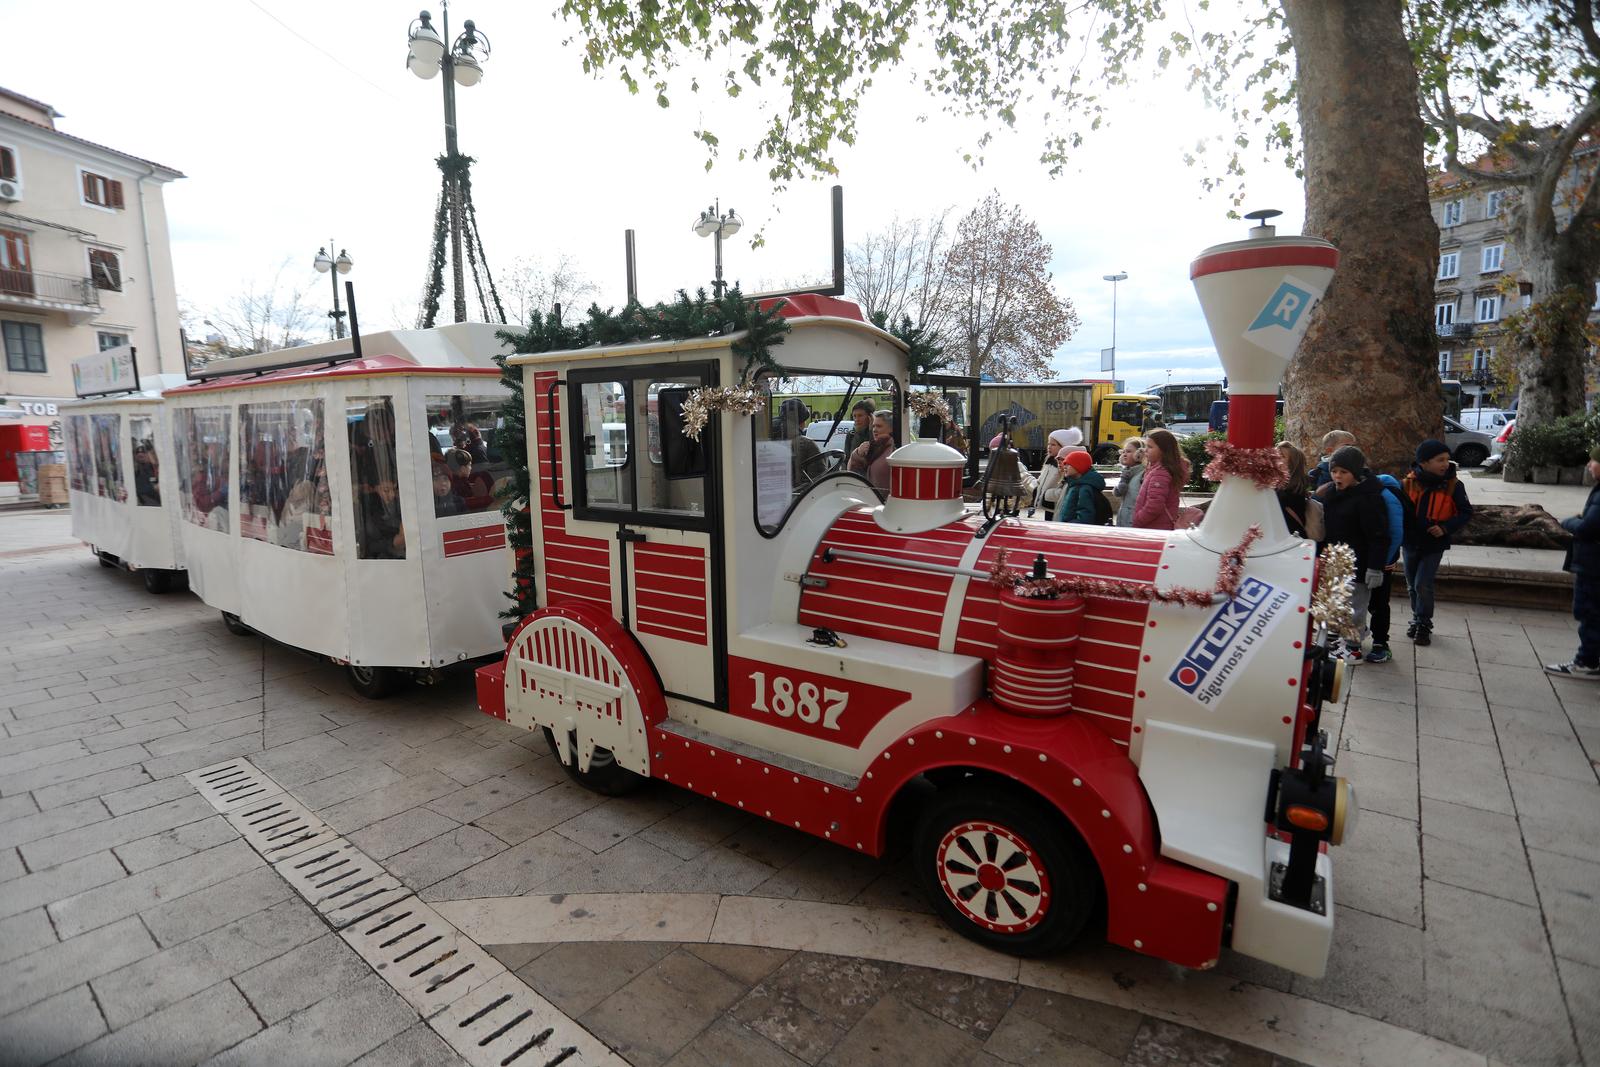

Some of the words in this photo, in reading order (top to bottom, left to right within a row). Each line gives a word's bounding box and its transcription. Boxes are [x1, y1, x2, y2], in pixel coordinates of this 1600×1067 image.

[1272, 292, 1299, 321] R
[20, 402, 59, 415] TOB
[1046, 400, 1079, 410] ROTO
[1197, 645, 1247, 704] Sigurnost
[1245, 634, 1254, 646] u
[1251, 591, 1290, 638] pokretu
[749, 671, 849, 730] 1887
